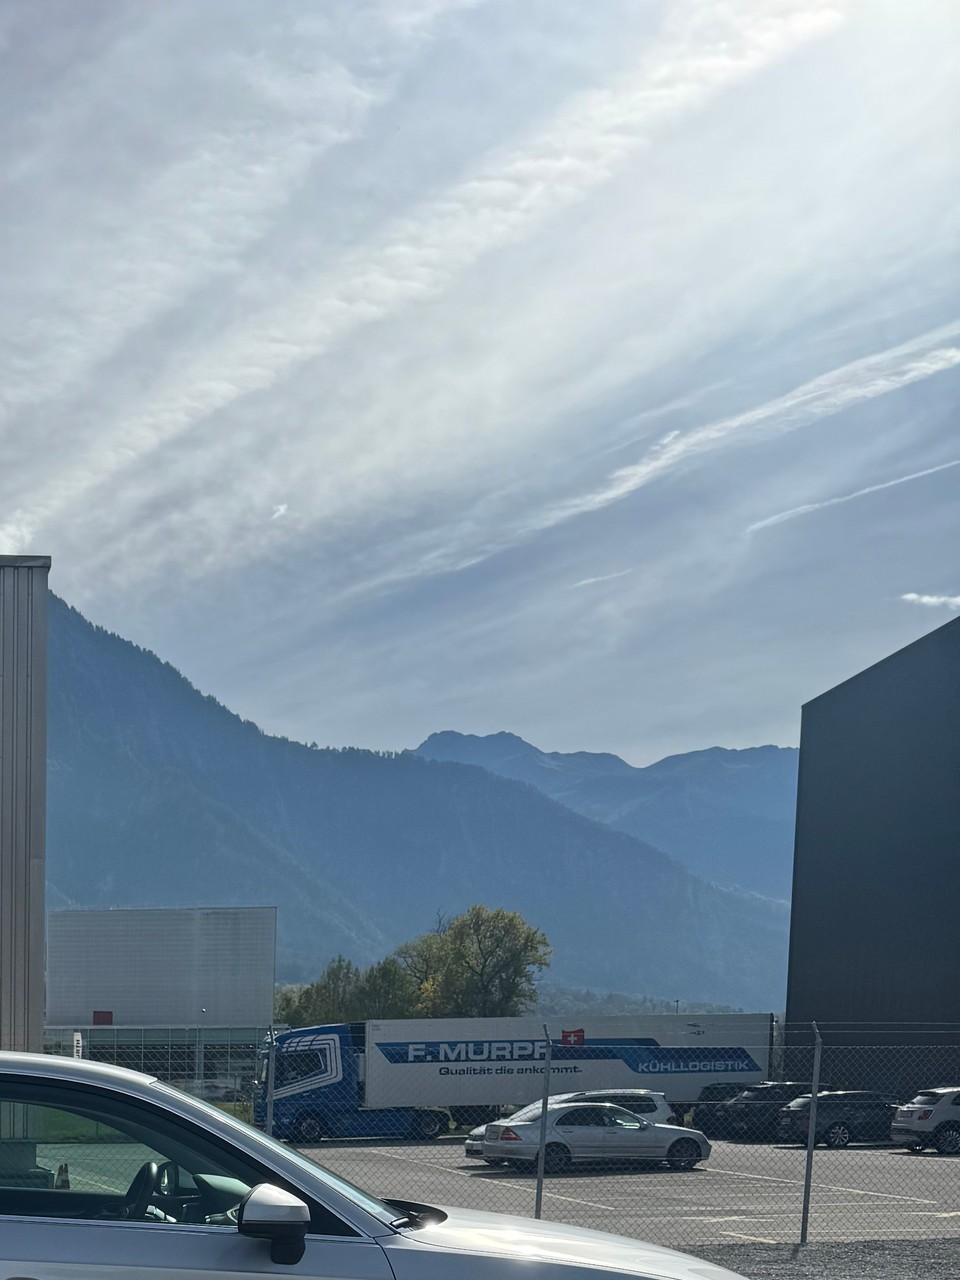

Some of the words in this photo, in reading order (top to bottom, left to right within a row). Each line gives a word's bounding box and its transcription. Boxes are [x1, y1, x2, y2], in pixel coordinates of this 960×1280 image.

[439, 1066, 493, 1076] Qualität
[495, 1066, 514, 1075] die
[638, 1061, 749, 1072] KÜHLLOGISTIK
